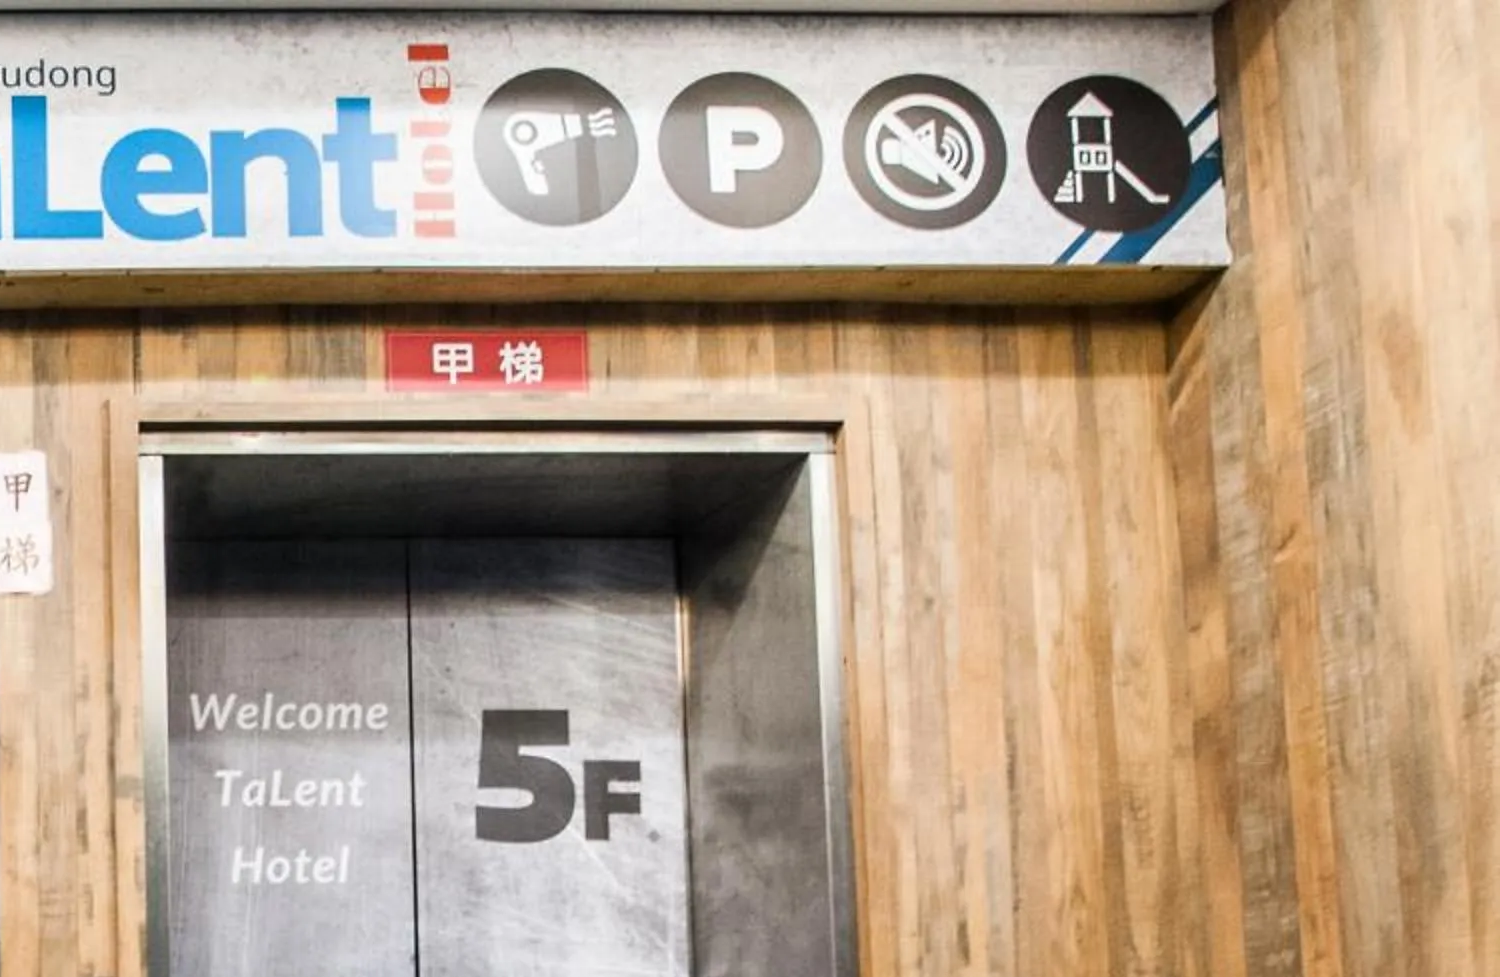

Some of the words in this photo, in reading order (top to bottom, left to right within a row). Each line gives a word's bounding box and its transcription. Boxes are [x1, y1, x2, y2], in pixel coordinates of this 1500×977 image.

[407, 44, 456, 238] Hotel
[706, 105, 784, 192] P
[432, 341, 544, 385] 甲梯
[0, 472, 40, 576] 甲梯
[189, 692, 389, 731] Welcome
[214, 769, 367, 808] TaLent
[475, 709, 642, 844] 5F
[231, 847, 350, 885] Hotel
